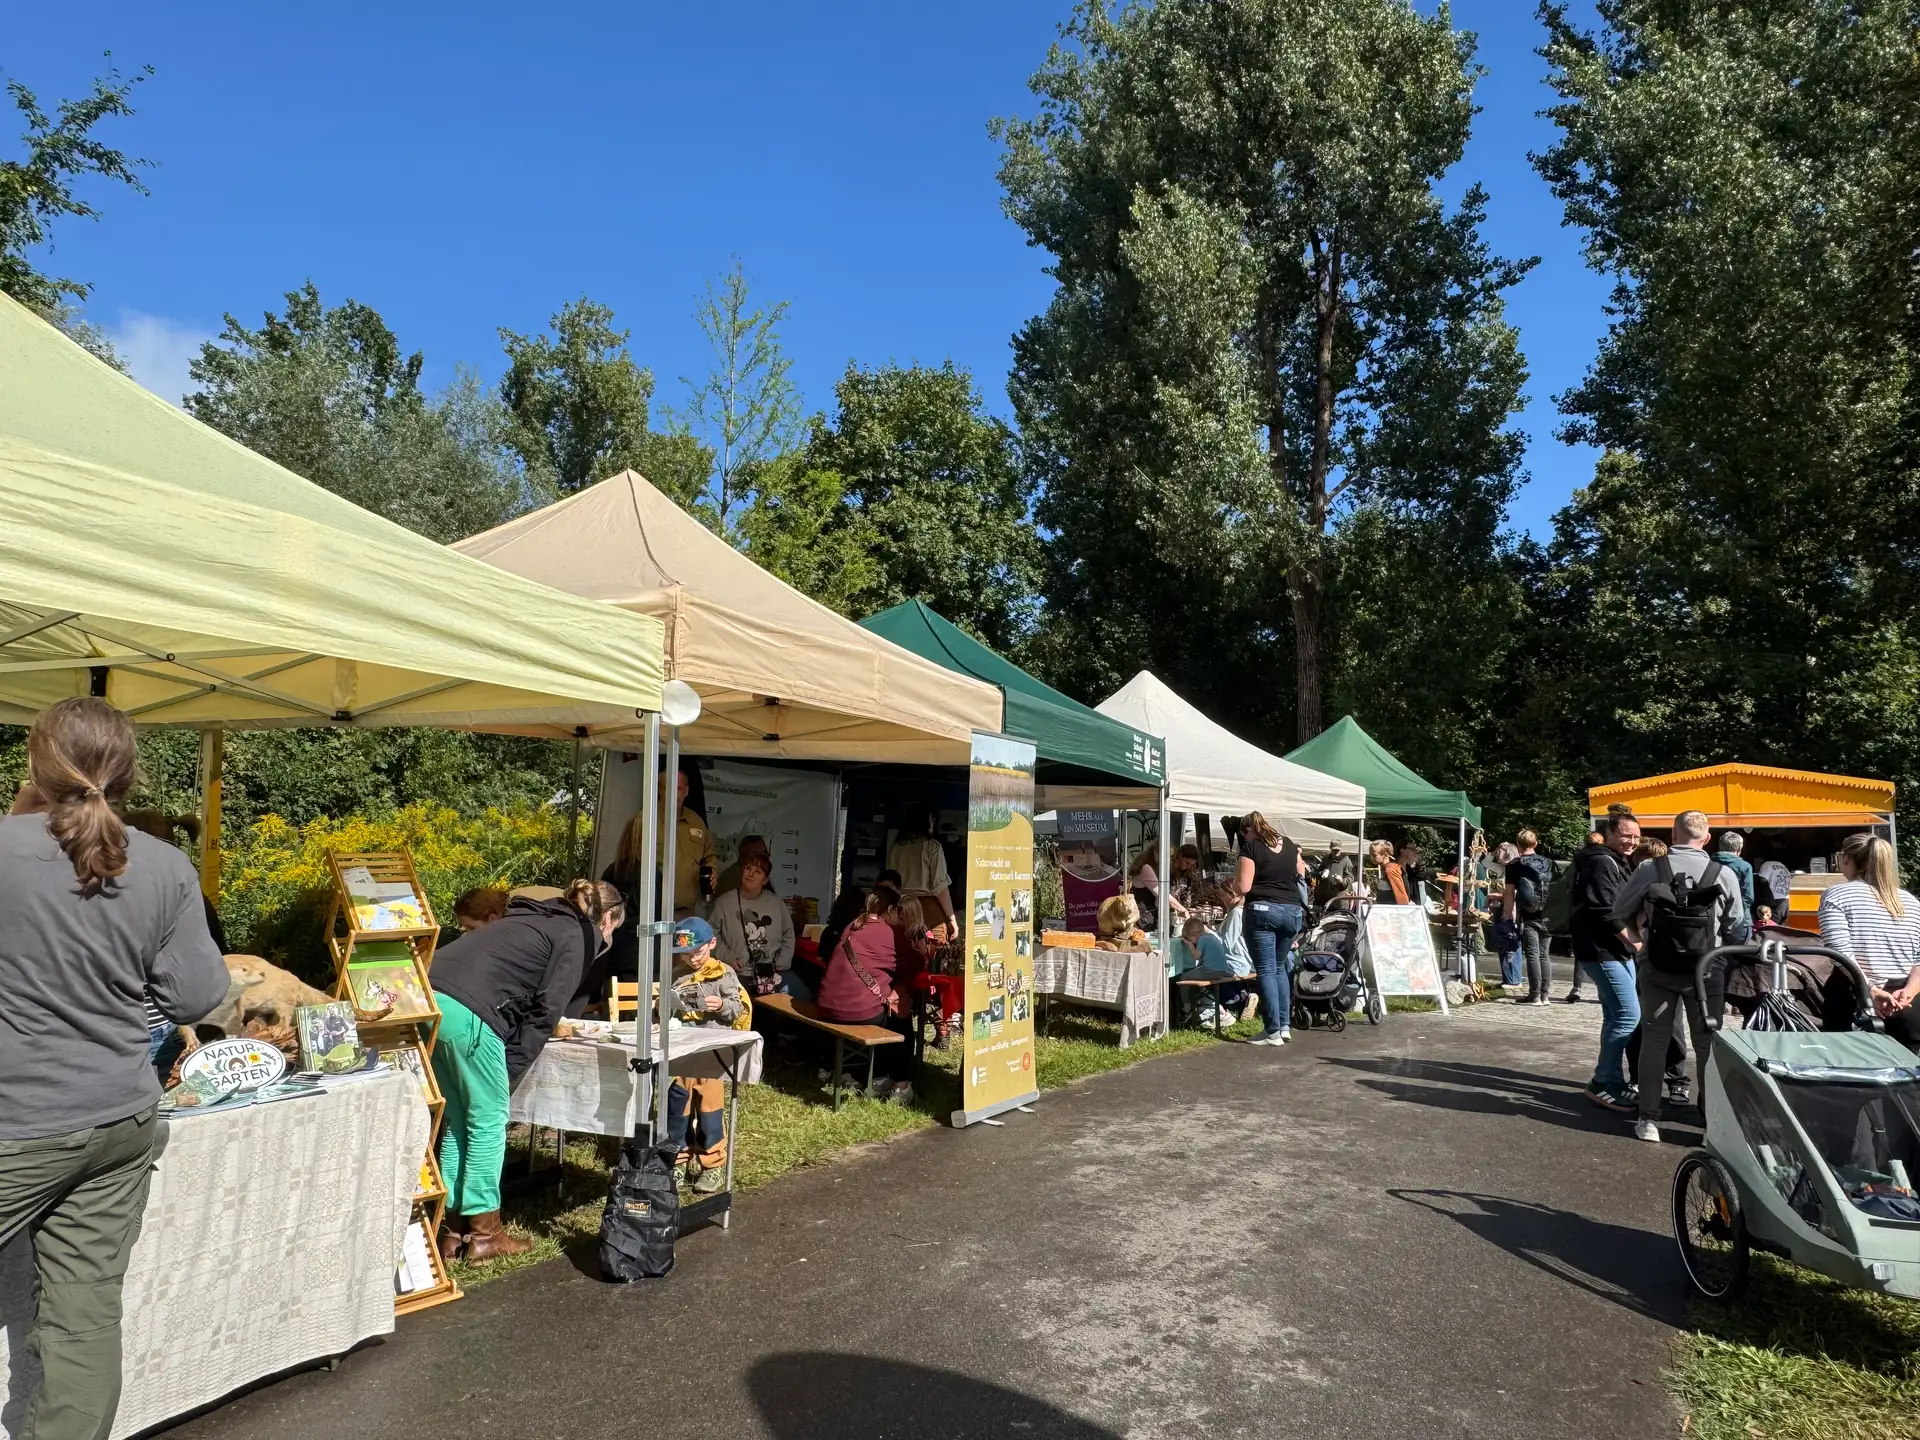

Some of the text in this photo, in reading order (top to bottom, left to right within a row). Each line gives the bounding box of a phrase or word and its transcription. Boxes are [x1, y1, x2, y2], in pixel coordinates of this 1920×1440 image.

[1070, 811, 1094, 821] MEHR
[204, 1043, 256, 1061] NATUR
[210, 1067, 271, 1088] GARTEN
